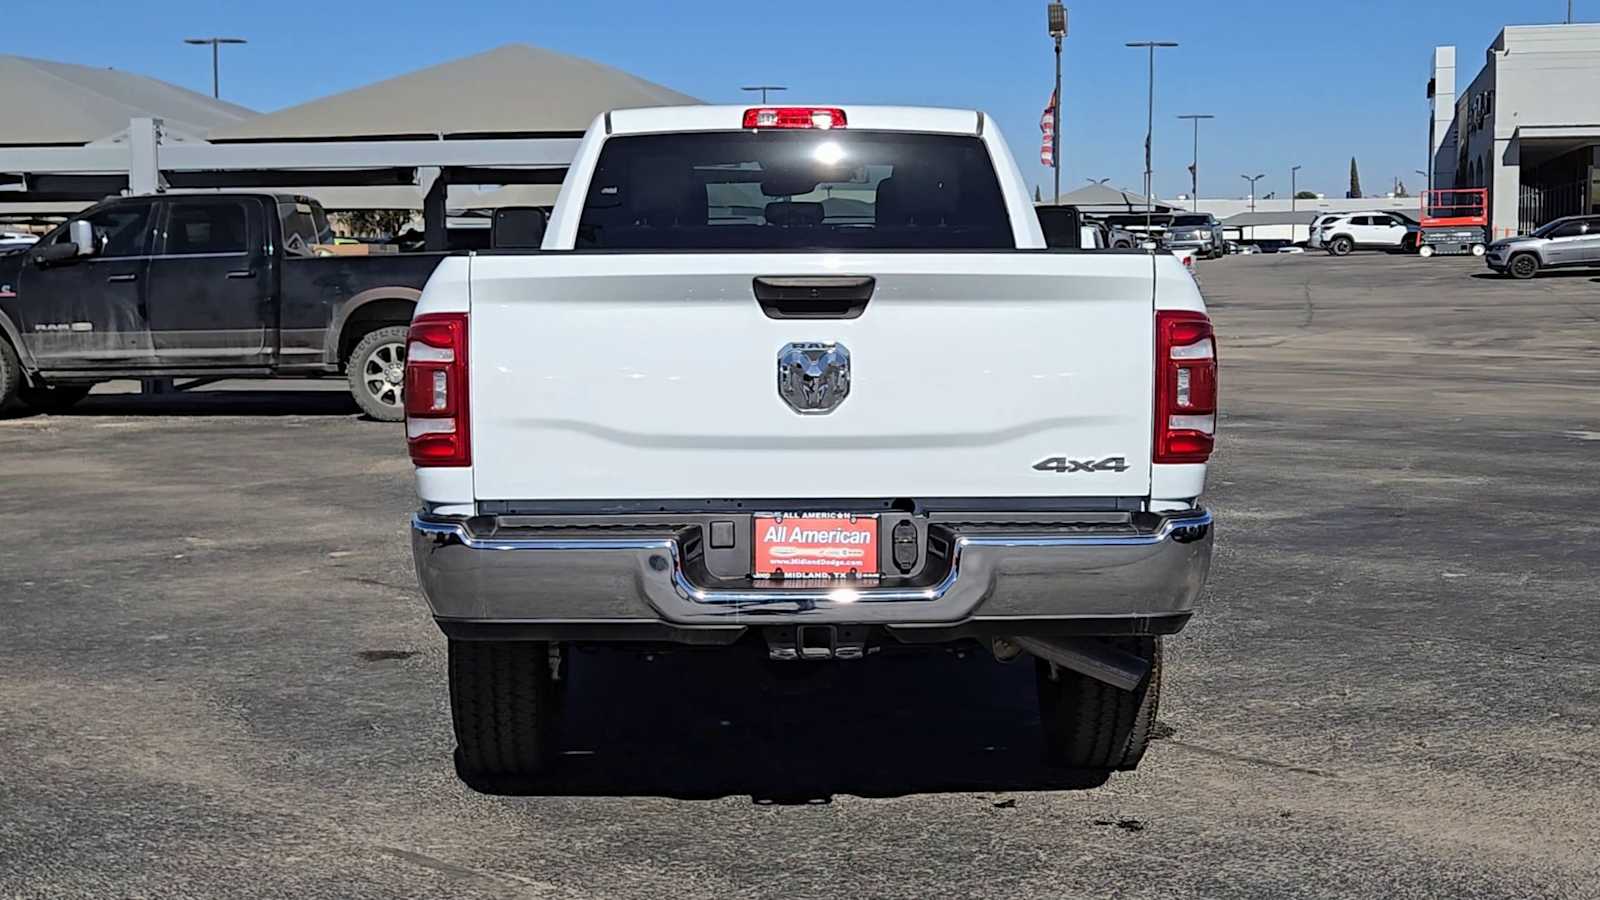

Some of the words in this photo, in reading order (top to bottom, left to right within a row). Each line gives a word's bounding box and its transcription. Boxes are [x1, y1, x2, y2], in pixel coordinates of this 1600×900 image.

[1032, 457, 1130, 473] 4x4
[764, 526, 786, 543] All
[789, 527, 871, 544] American
[770, 559, 864, 567] www.MidlandDodge.com
